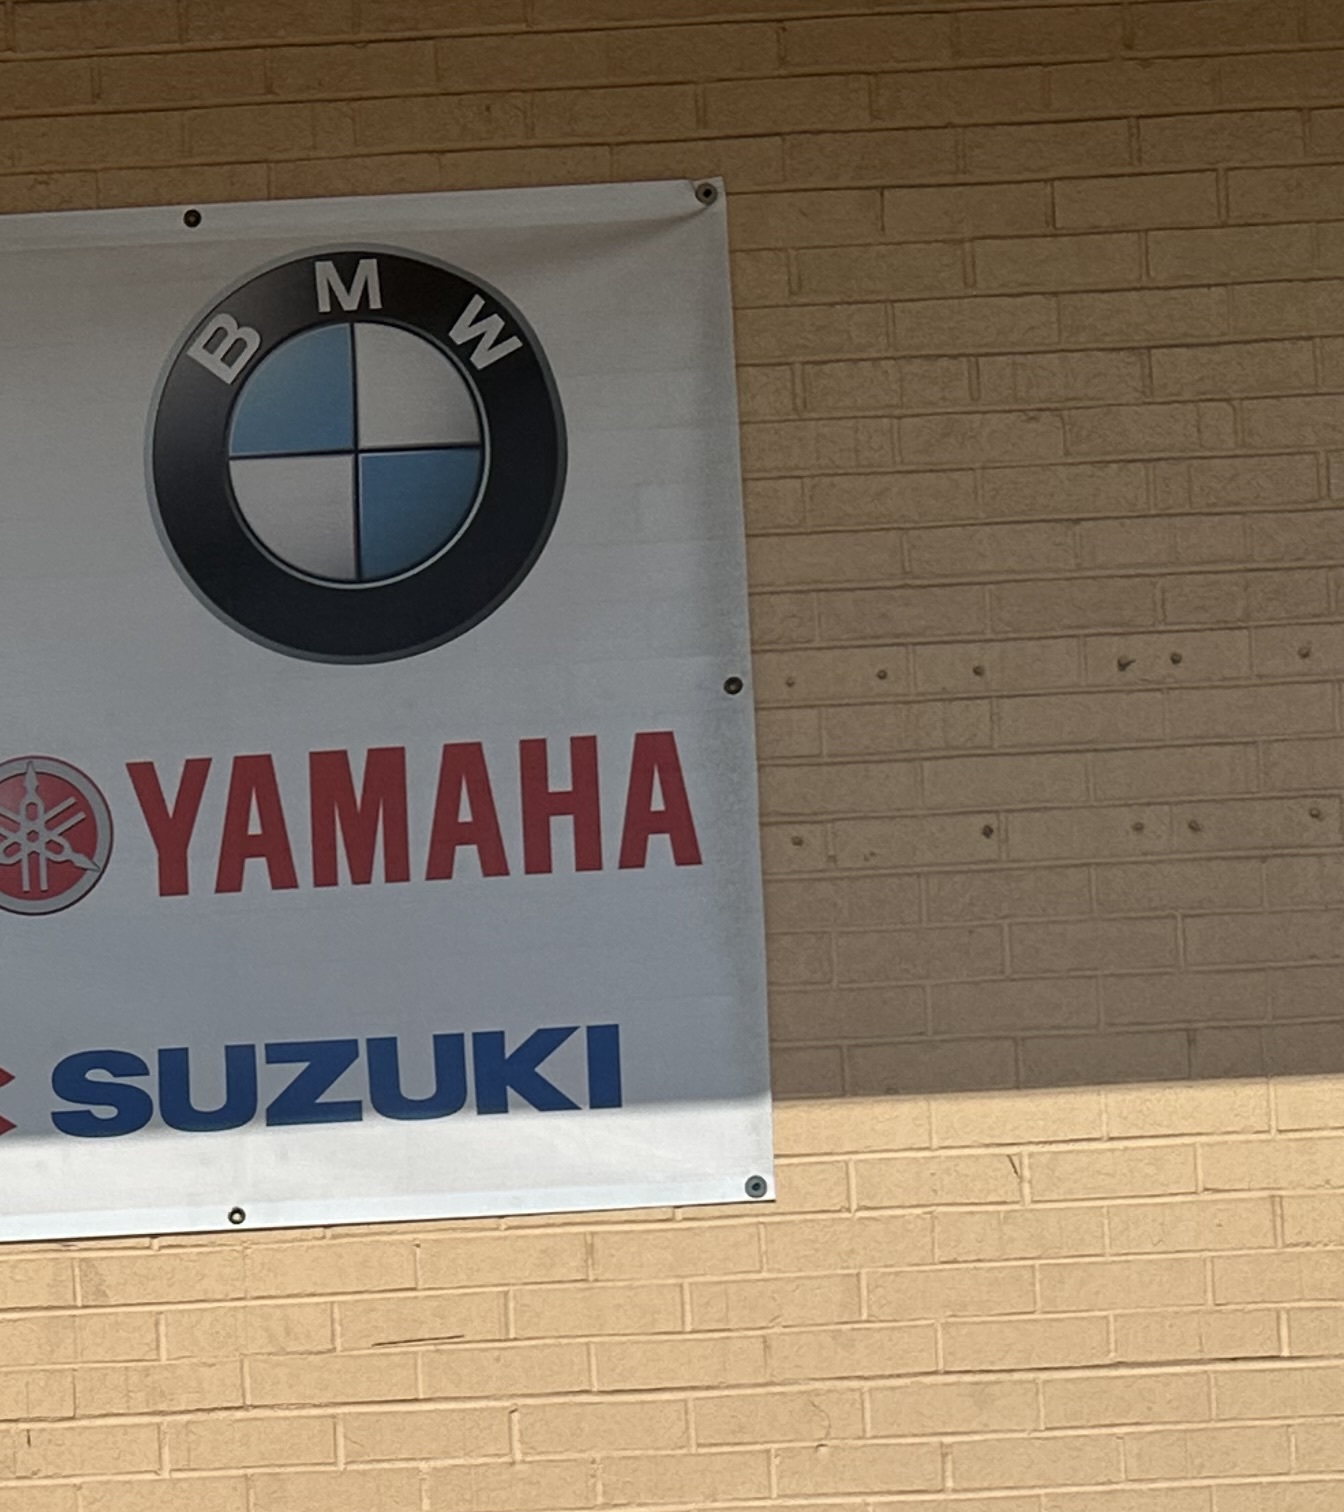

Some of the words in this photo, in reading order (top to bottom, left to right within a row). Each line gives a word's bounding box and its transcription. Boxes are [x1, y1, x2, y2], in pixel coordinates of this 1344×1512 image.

[186, 257, 523, 386] BMW
[125, 729, 704, 898] YAMAHA
[49, 1023, 623, 1139] SUZUKI
